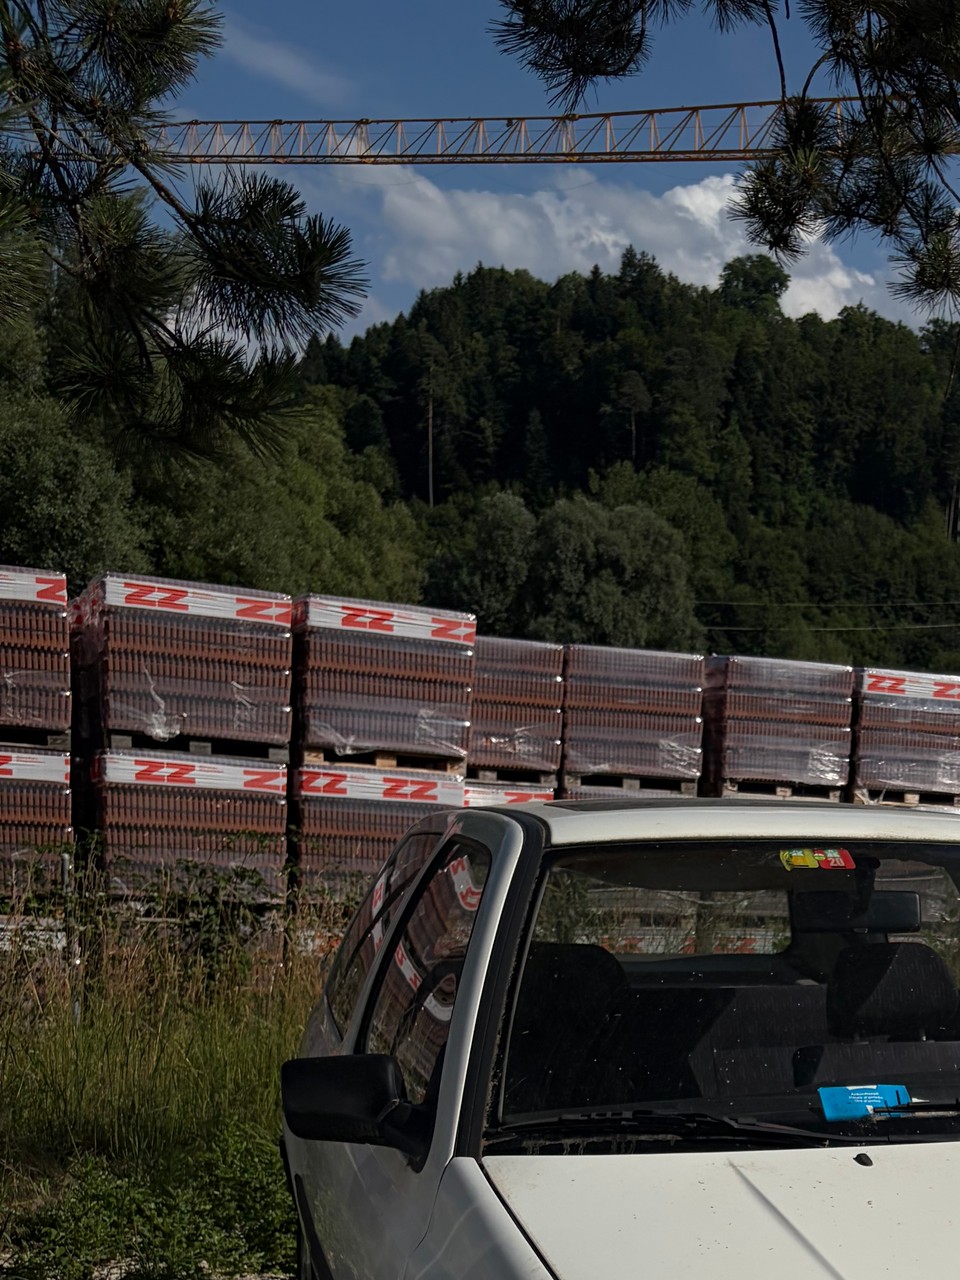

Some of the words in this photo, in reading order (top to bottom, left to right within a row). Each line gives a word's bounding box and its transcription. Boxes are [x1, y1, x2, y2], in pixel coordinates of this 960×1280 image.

[123, 582, 189, 611] ZZ
[341, 605, 394, 632] ZZ
[867, 674, 906, 694] ZZ
[134, 759, 196, 784] ZZ
[383, 777, 438, 800] ZZ
[829, 857, 845, 866] 20
